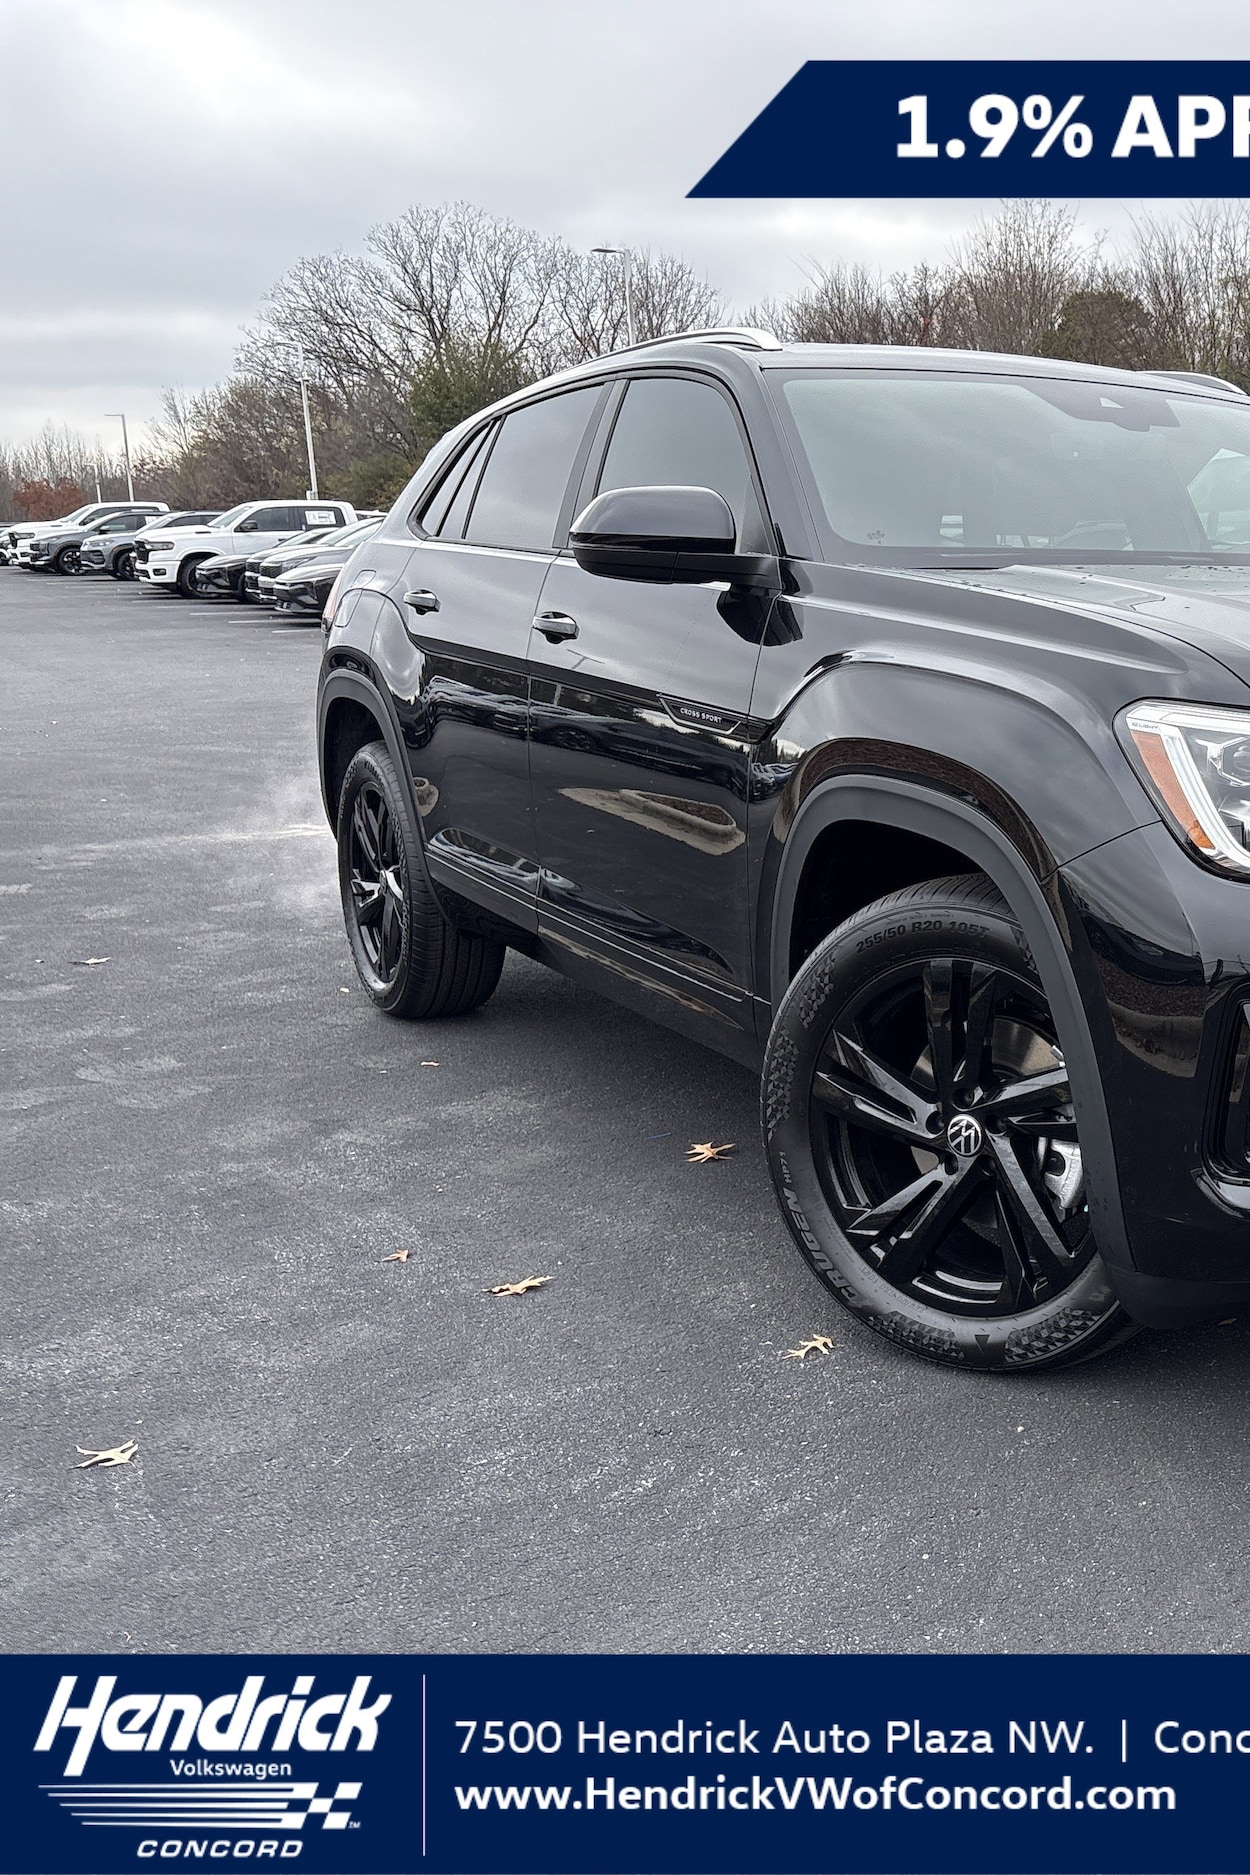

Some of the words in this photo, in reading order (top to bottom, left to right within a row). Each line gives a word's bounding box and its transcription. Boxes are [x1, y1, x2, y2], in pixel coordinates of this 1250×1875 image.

[680, 707, 700, 719] CROSS
[701, 712, 722, 723] SPORT
[856, 923, 906, 954] 255/50
[911, 920, 943, 934] R20
[950, 920, 991, 939] 105T
[779, 1151, 792, 1184] HP71
[783, 1187, 861, 1304] CRUGEN
